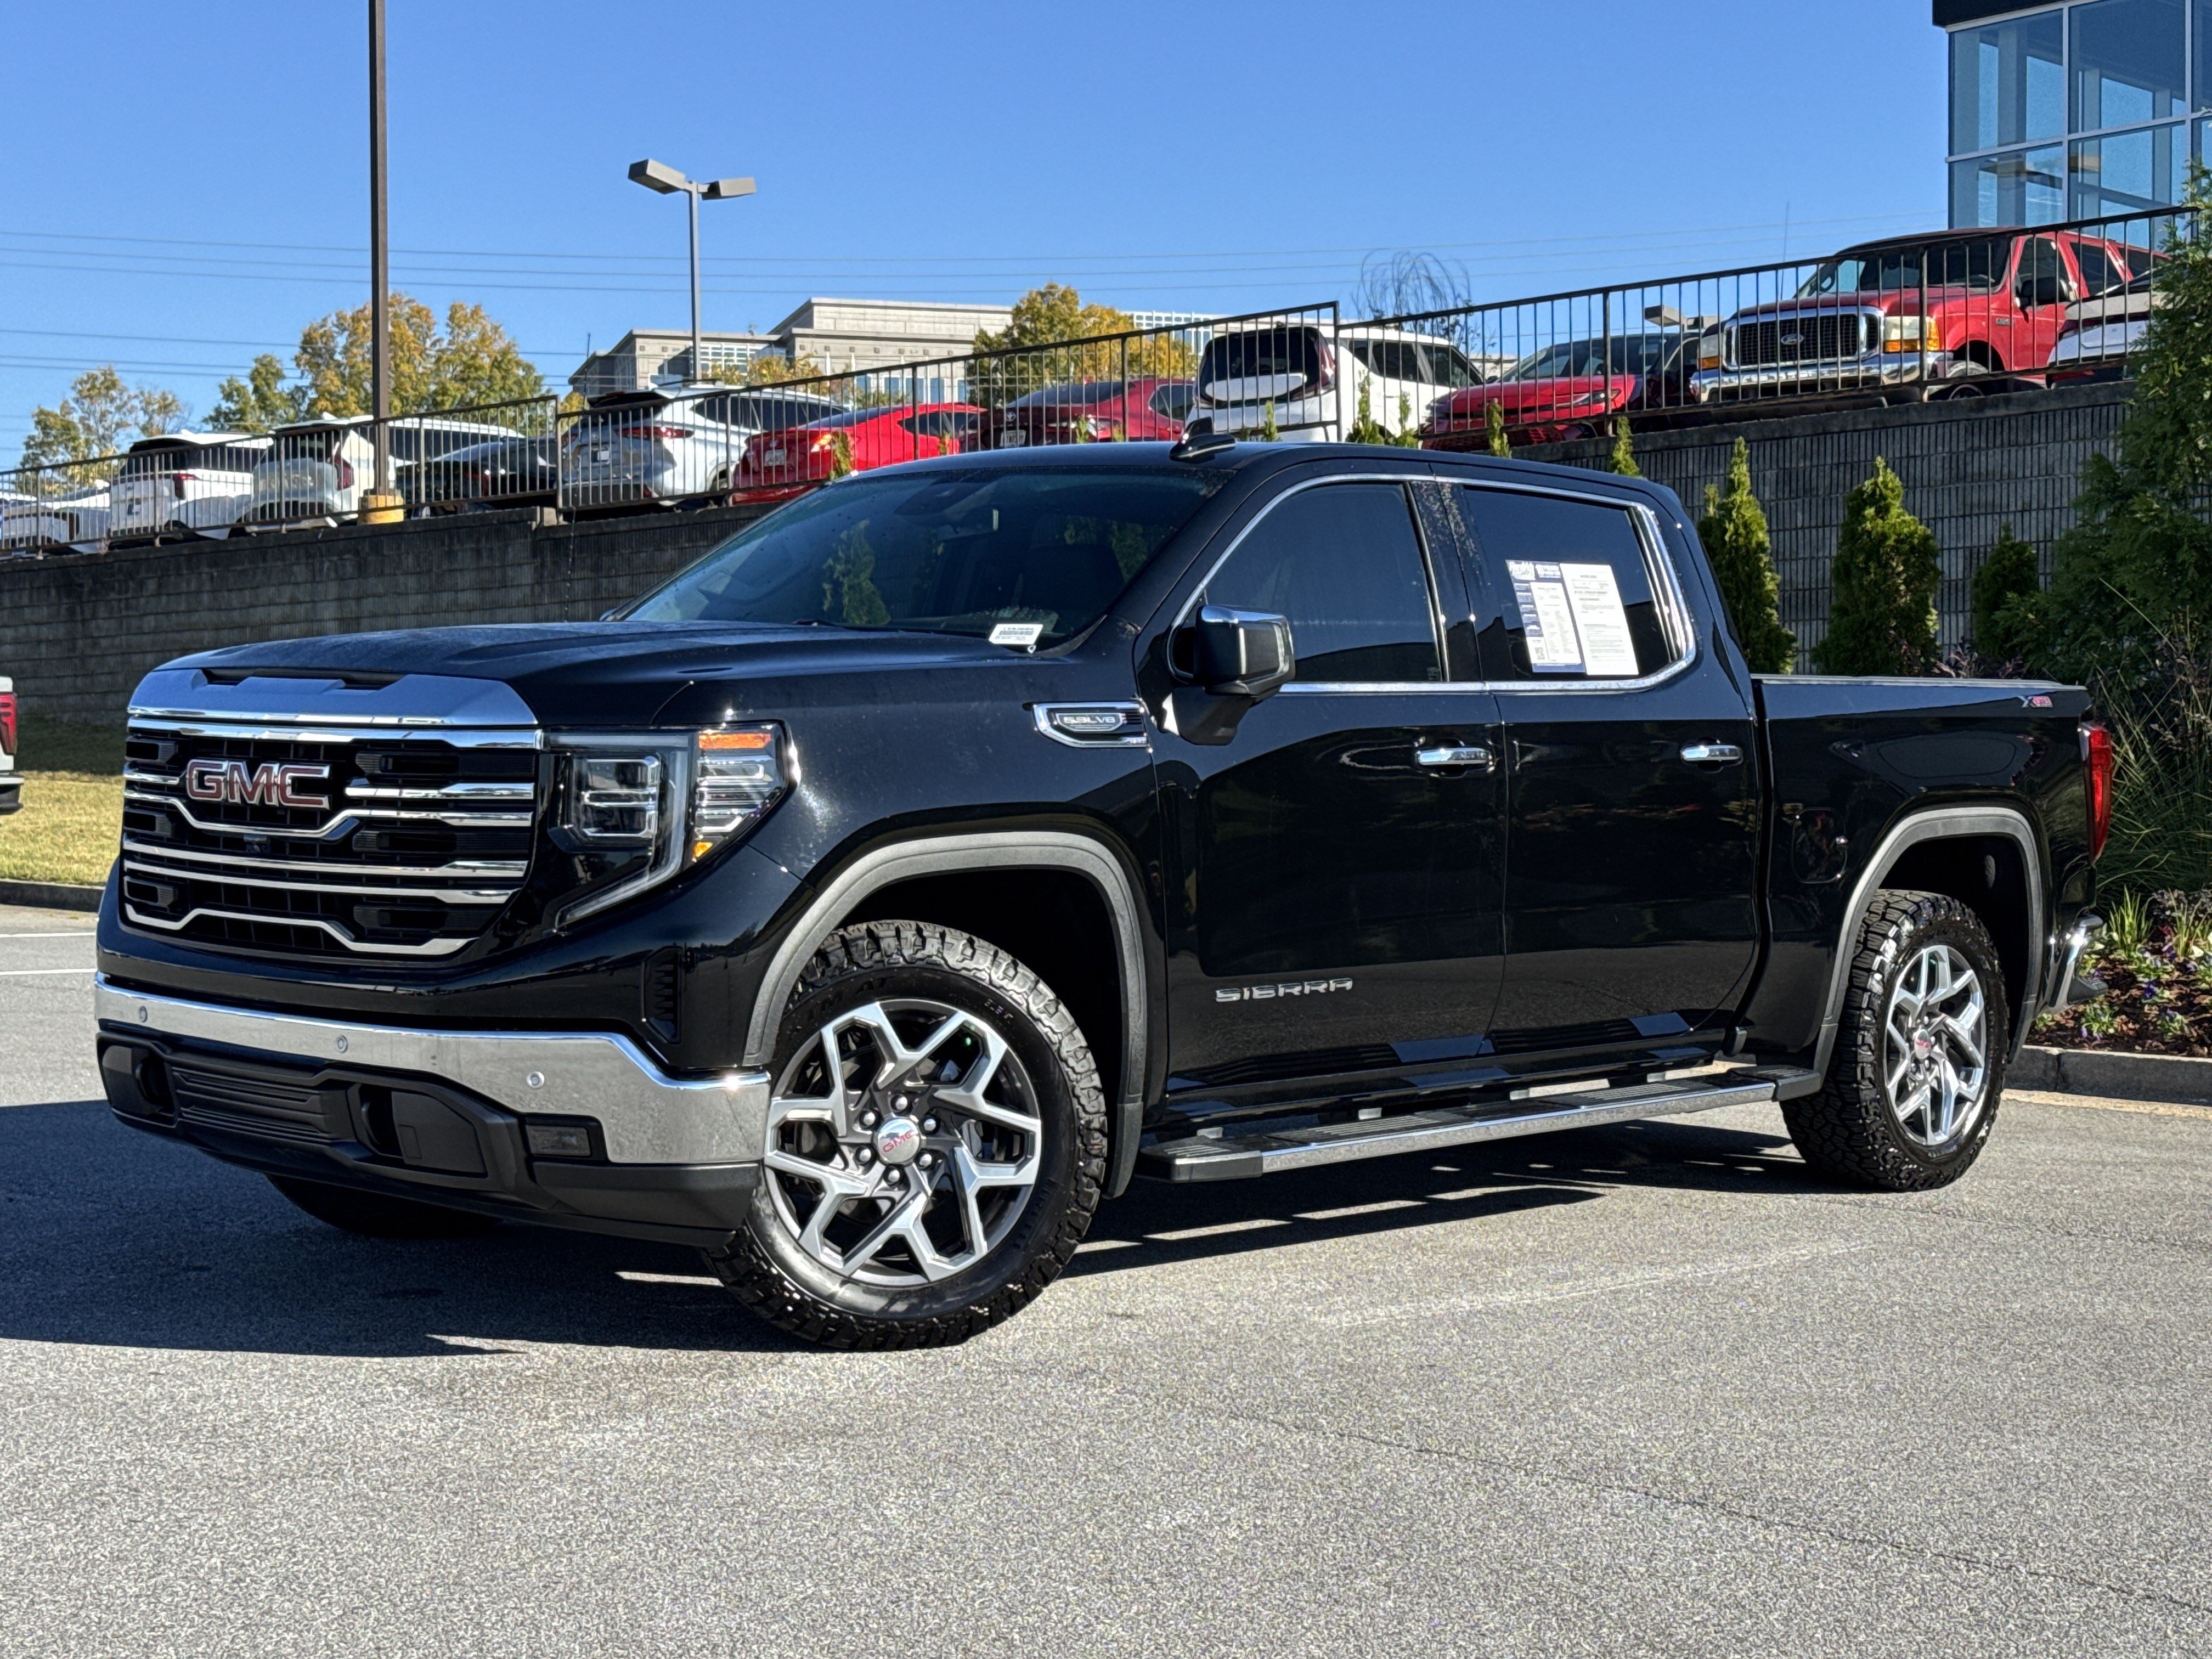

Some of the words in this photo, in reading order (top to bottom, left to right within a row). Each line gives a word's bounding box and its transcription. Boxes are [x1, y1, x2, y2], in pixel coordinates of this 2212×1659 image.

[186, 759, 331, 810] GMC
[1215, 977, 1353, 1003] SIERRA
[882, 1130, 919, 1153] GMC
